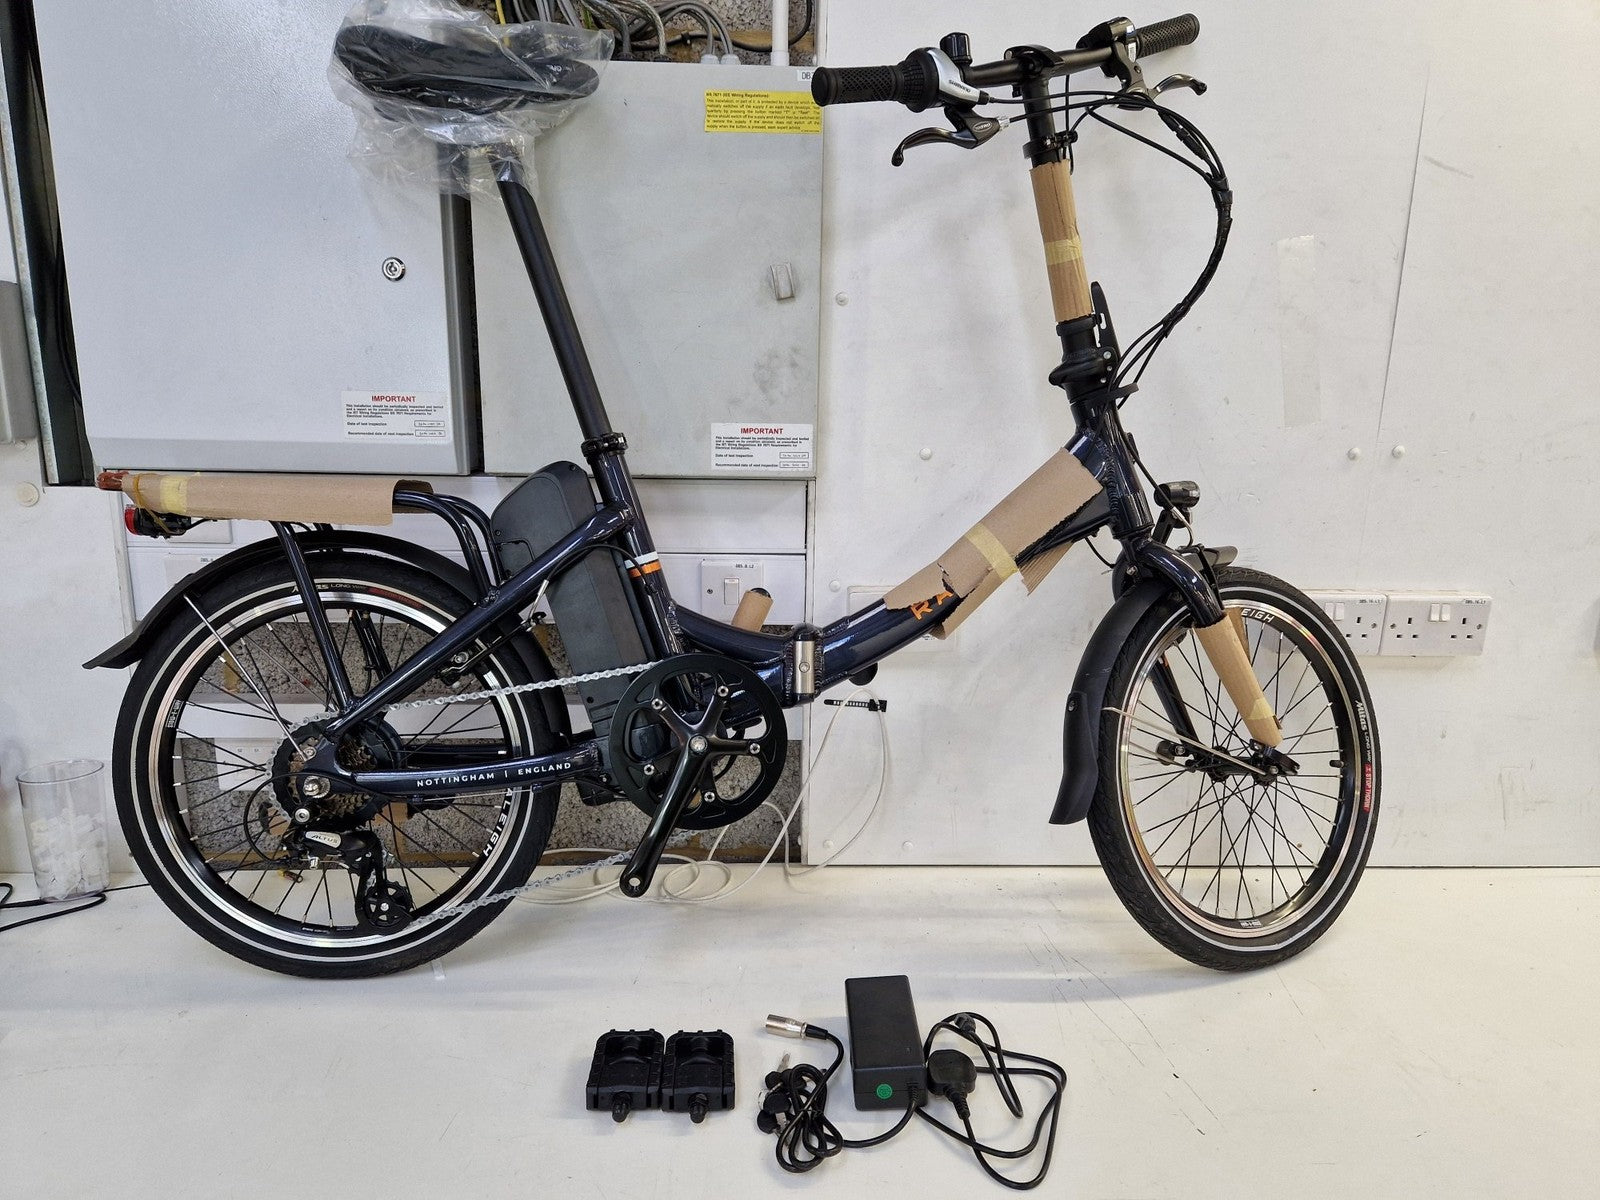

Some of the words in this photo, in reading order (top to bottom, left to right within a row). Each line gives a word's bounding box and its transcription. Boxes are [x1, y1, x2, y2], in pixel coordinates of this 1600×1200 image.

[1241, 608, 1274, 622] EIGH
[1356, 700, 1368, 731] Mitas
[417, 772, 494, 787] NOTTINGHAM
[518, 762, 571, 776] ENGLAND
[483, 788, 512, 856] ALEIGH
